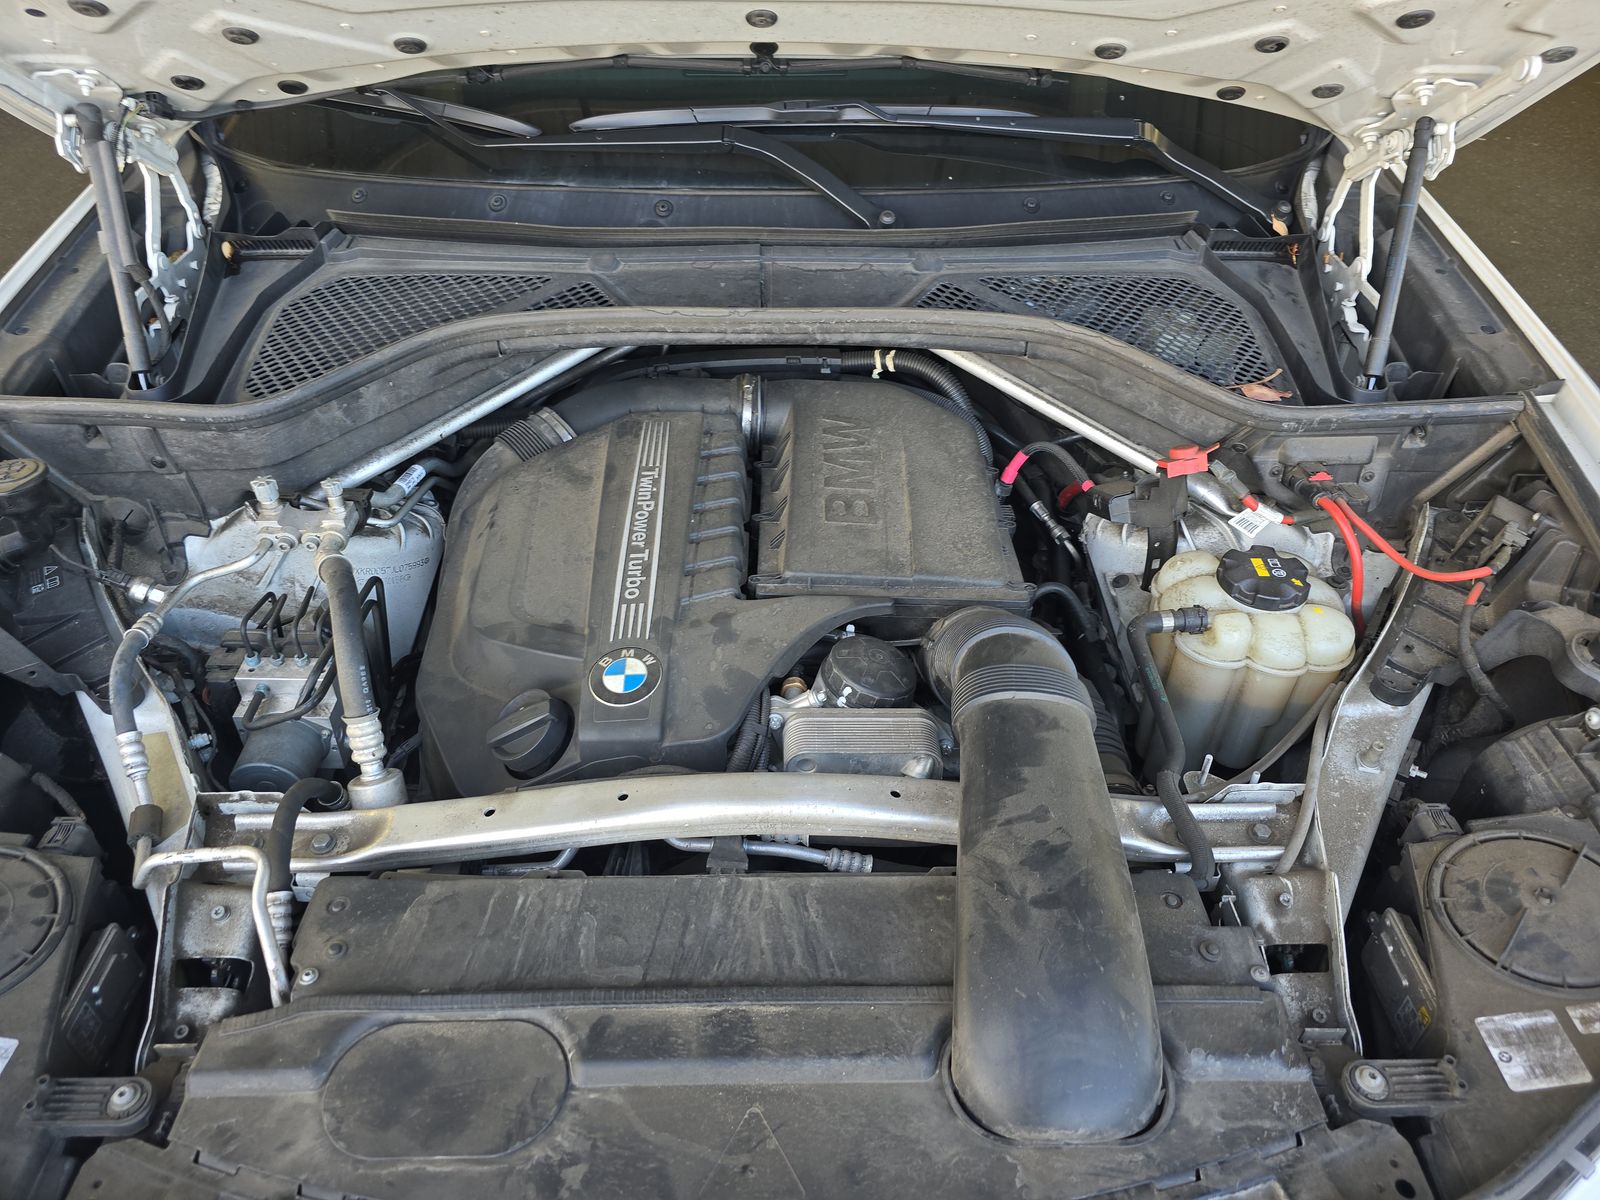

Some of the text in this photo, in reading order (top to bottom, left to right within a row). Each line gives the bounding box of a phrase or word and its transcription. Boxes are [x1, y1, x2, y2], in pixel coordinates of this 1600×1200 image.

[820, 416, 882, 526] BMW
[624, 467, 660, 600] TwinPower Turbo
[598, 649, 657, 667] BMW
